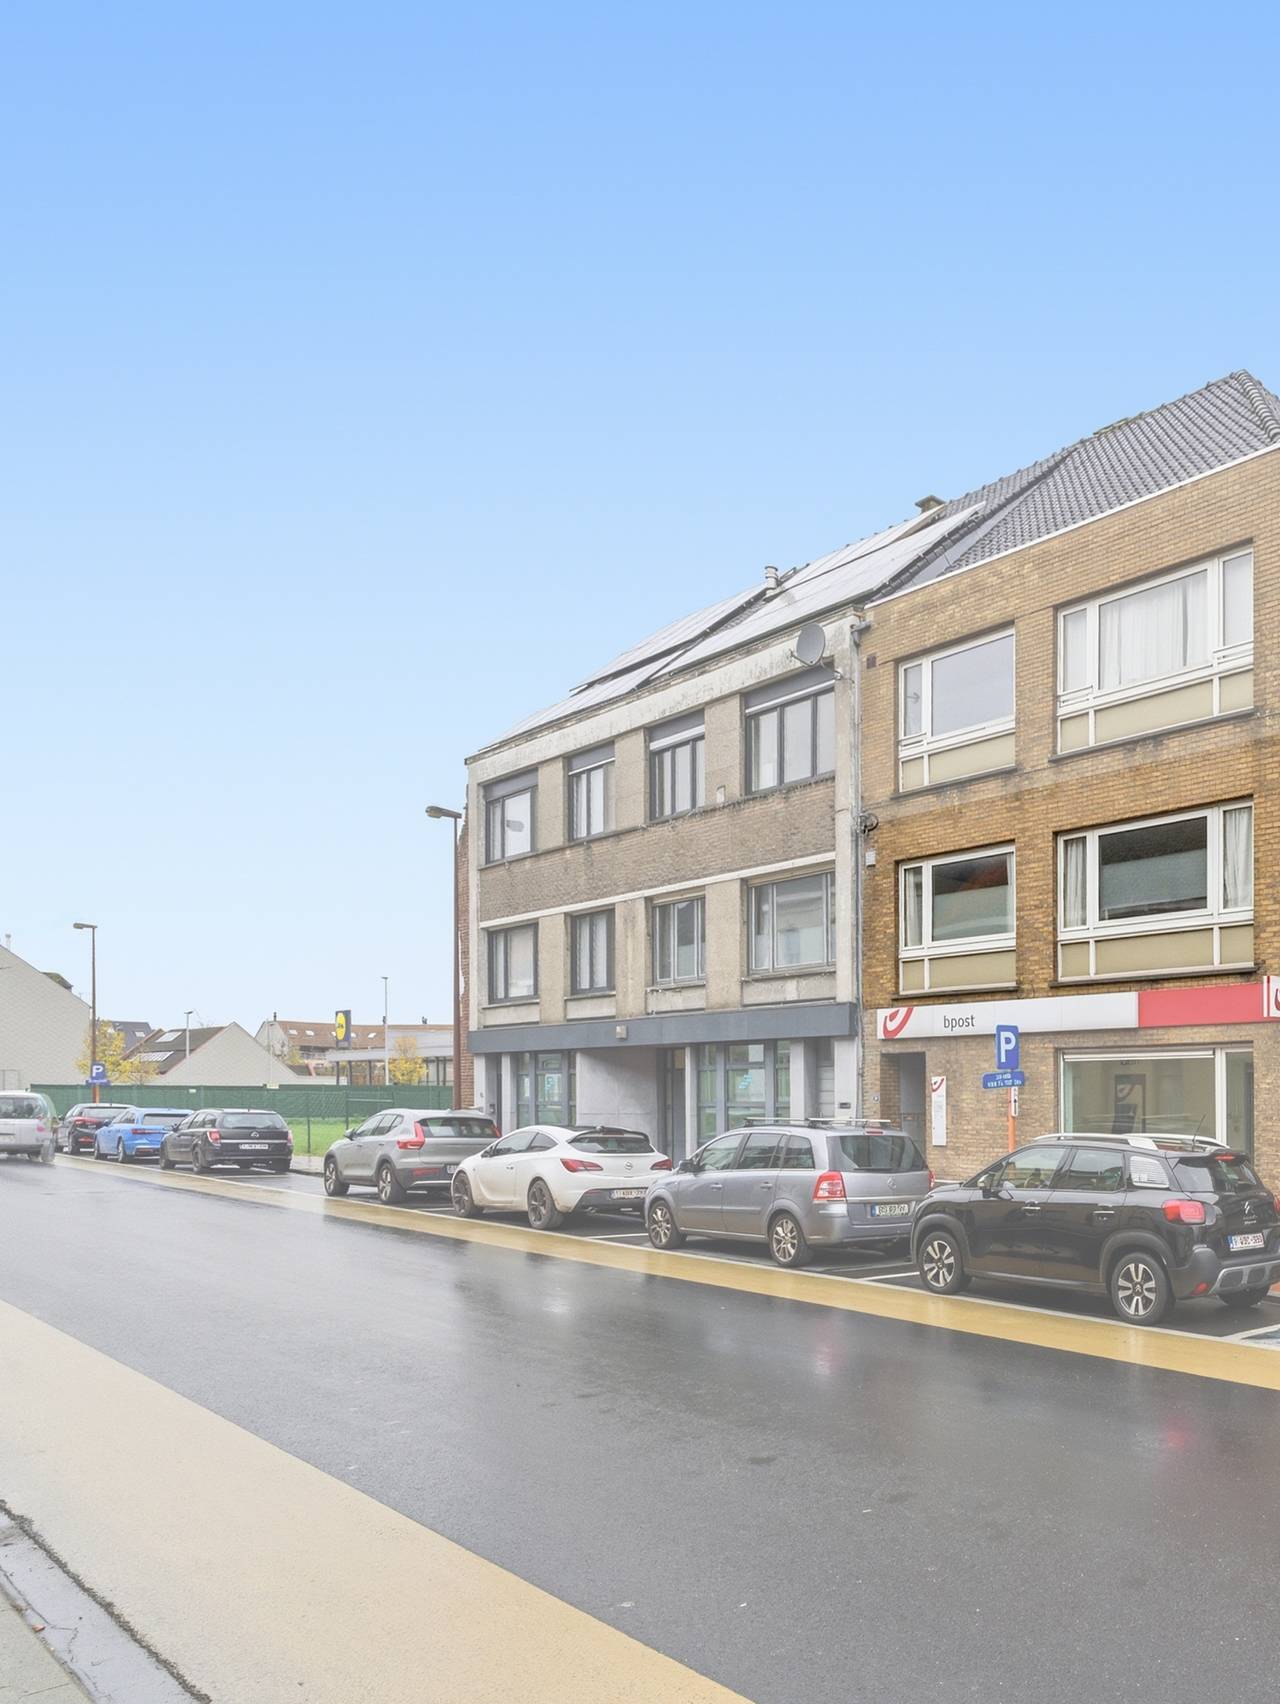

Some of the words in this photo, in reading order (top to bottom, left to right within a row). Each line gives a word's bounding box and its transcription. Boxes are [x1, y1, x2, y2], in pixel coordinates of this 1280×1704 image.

[943, 1014, 976, 1032] bpost
[1000, 1031, 1016, 1063] P
[92, 1065, 104, 1077] P
